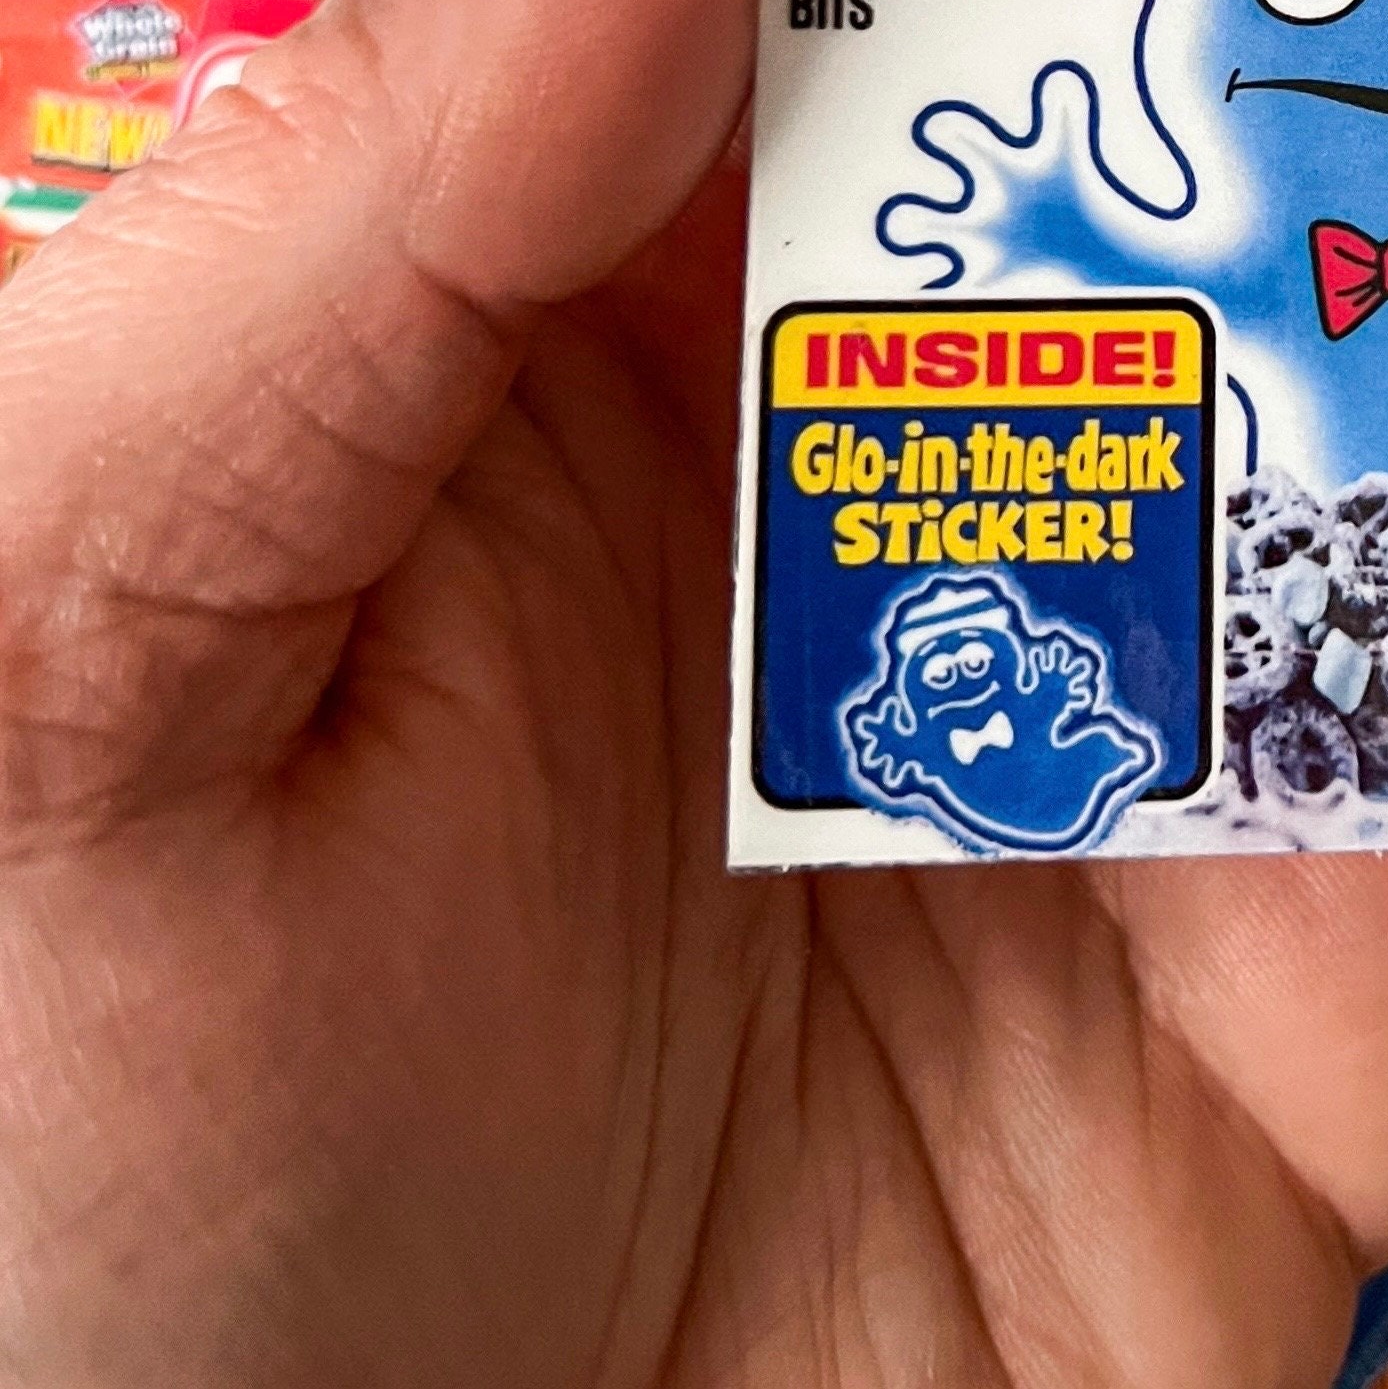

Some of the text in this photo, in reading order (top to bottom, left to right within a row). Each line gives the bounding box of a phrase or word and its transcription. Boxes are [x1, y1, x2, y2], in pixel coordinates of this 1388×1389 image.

[82, 2, 184, 41] Whole
[804, 330, 1176, 390] INSIDE!
[791, 417, 1186, 496] Glo-in-the-dark
